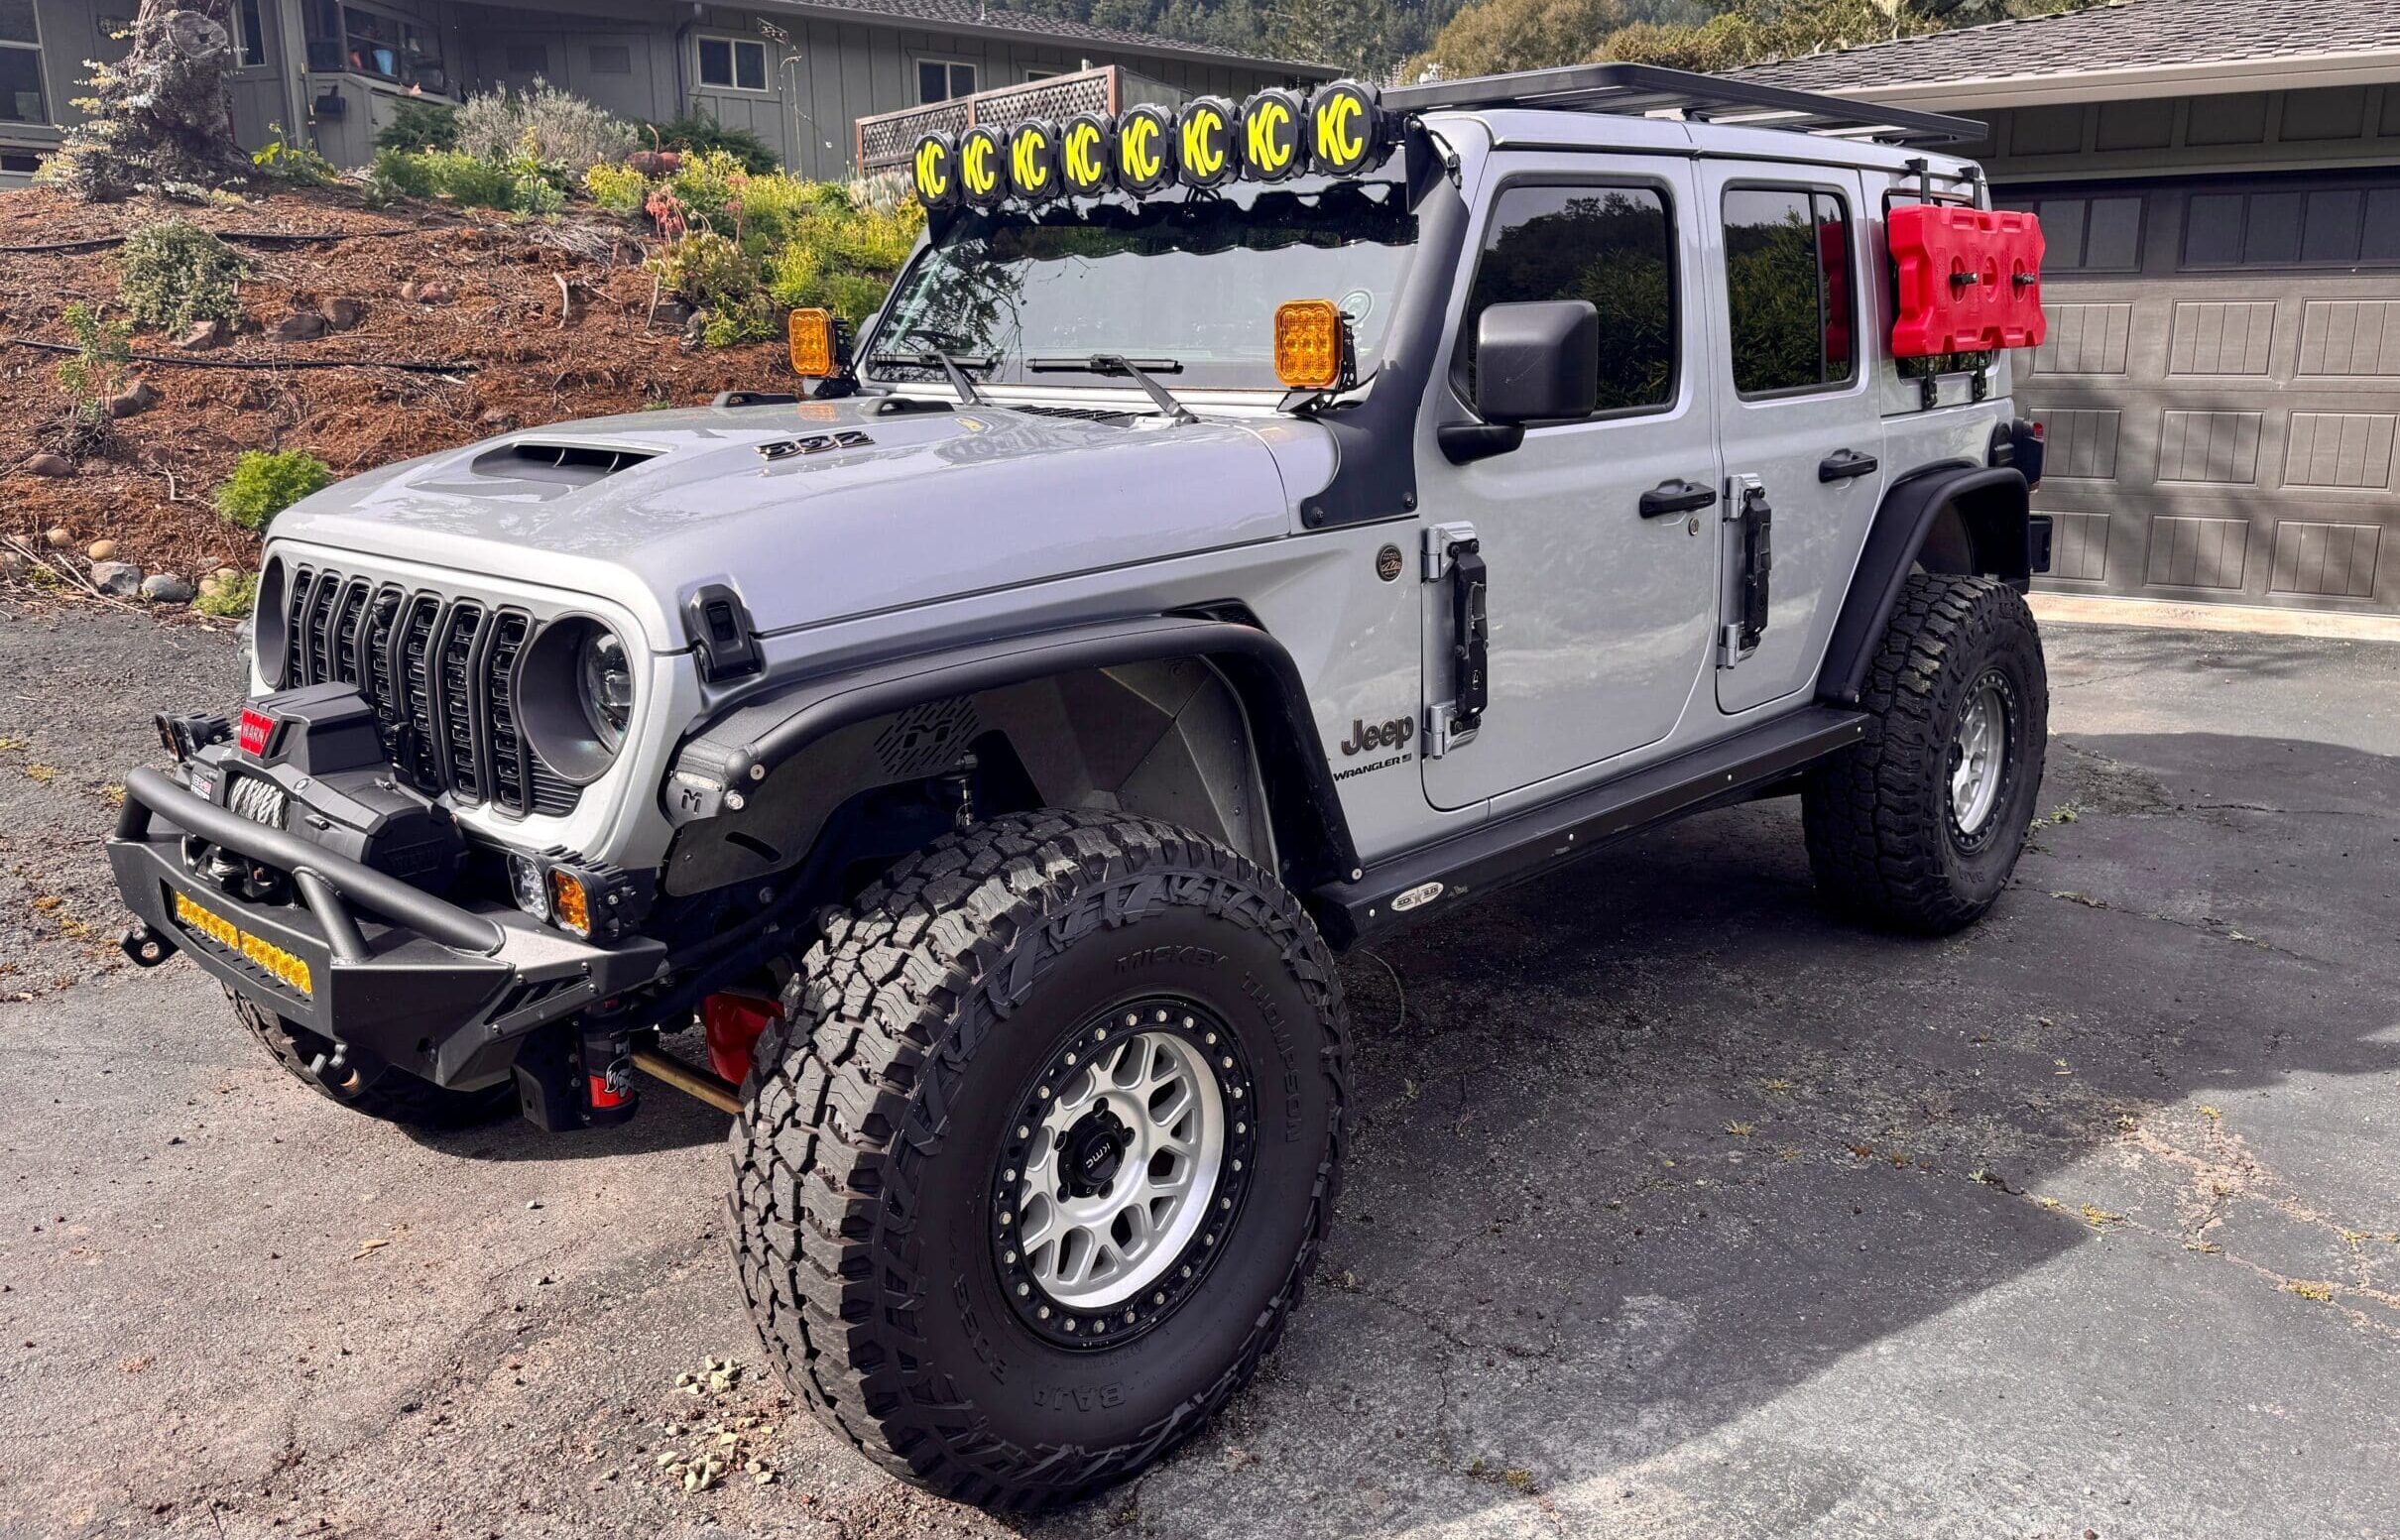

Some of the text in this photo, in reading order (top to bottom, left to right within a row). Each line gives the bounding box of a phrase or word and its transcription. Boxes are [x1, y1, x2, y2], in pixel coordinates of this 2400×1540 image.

[1067, 127, 1101, 182] KC
[1125, 120, 1159, 178] KC
[1185, 113, 1222, 174] KC
[1250, 105, 1289, 169] KC
[1319, 96, 1362, 163] KC
[917, 144, 945, 193] KC
[965, 139, 994, 190] KC
[1015, 133, 1045, 186] KC
[243, 723, 265, 744] WARN
[1340, 715, 1414, 757] Jeep
[1333, 756, 1400, 781] WRANGLER
[1114, 945, 1302, 1142] MICKEY THOMPSON
[1032, 1382, 1127, 1412] BAJA
